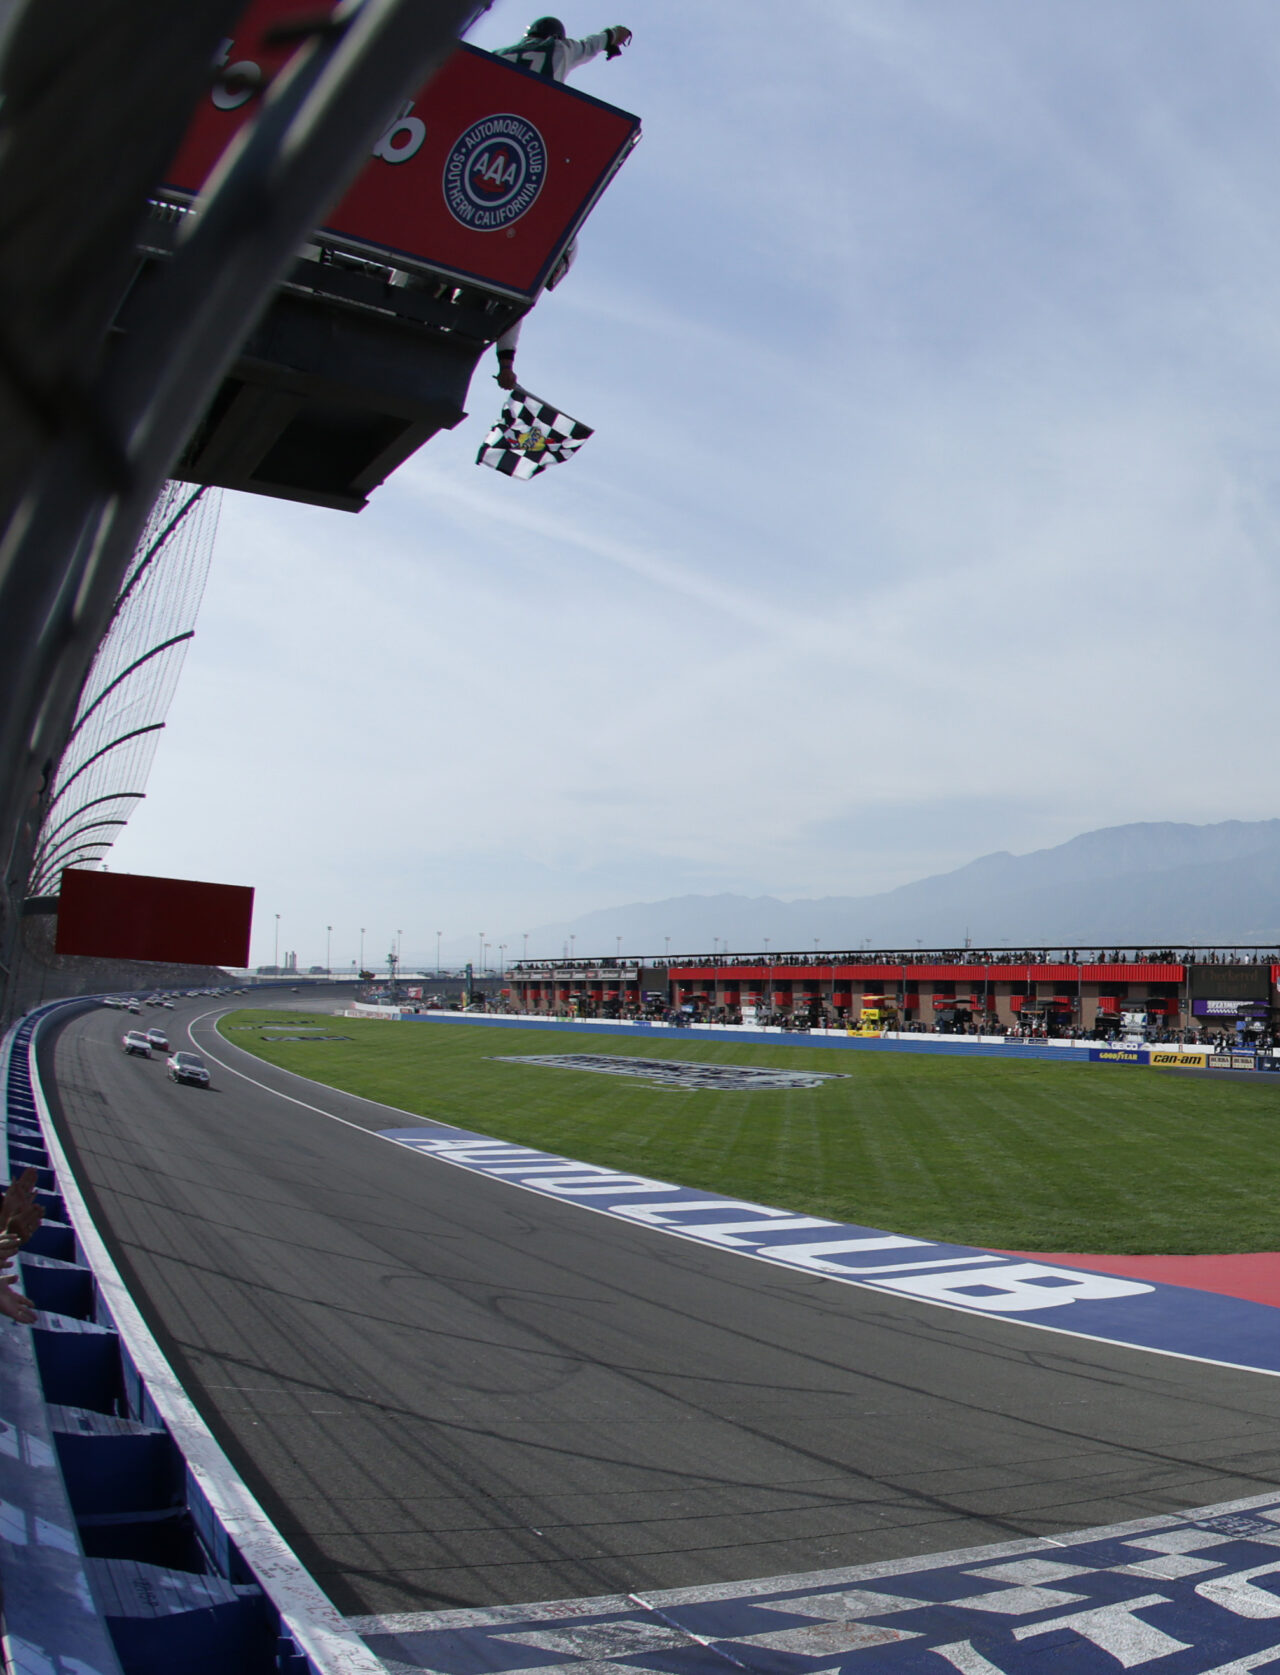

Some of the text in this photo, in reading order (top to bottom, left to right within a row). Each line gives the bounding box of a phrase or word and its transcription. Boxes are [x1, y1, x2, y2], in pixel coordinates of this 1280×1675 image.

[464, 119, 542, 173] AUTOMOBILE CLUB
[448, 153, 537, 225] SOUTHERN CALIFORNIA
[473, 152, 517, 185] AAA
[1099, 1052, 1138, 1061] GOODYEAR
[1153, 1055, 1202, 1065] can-am
[396, 1138, 1156, 1311] AUTO CLUB
